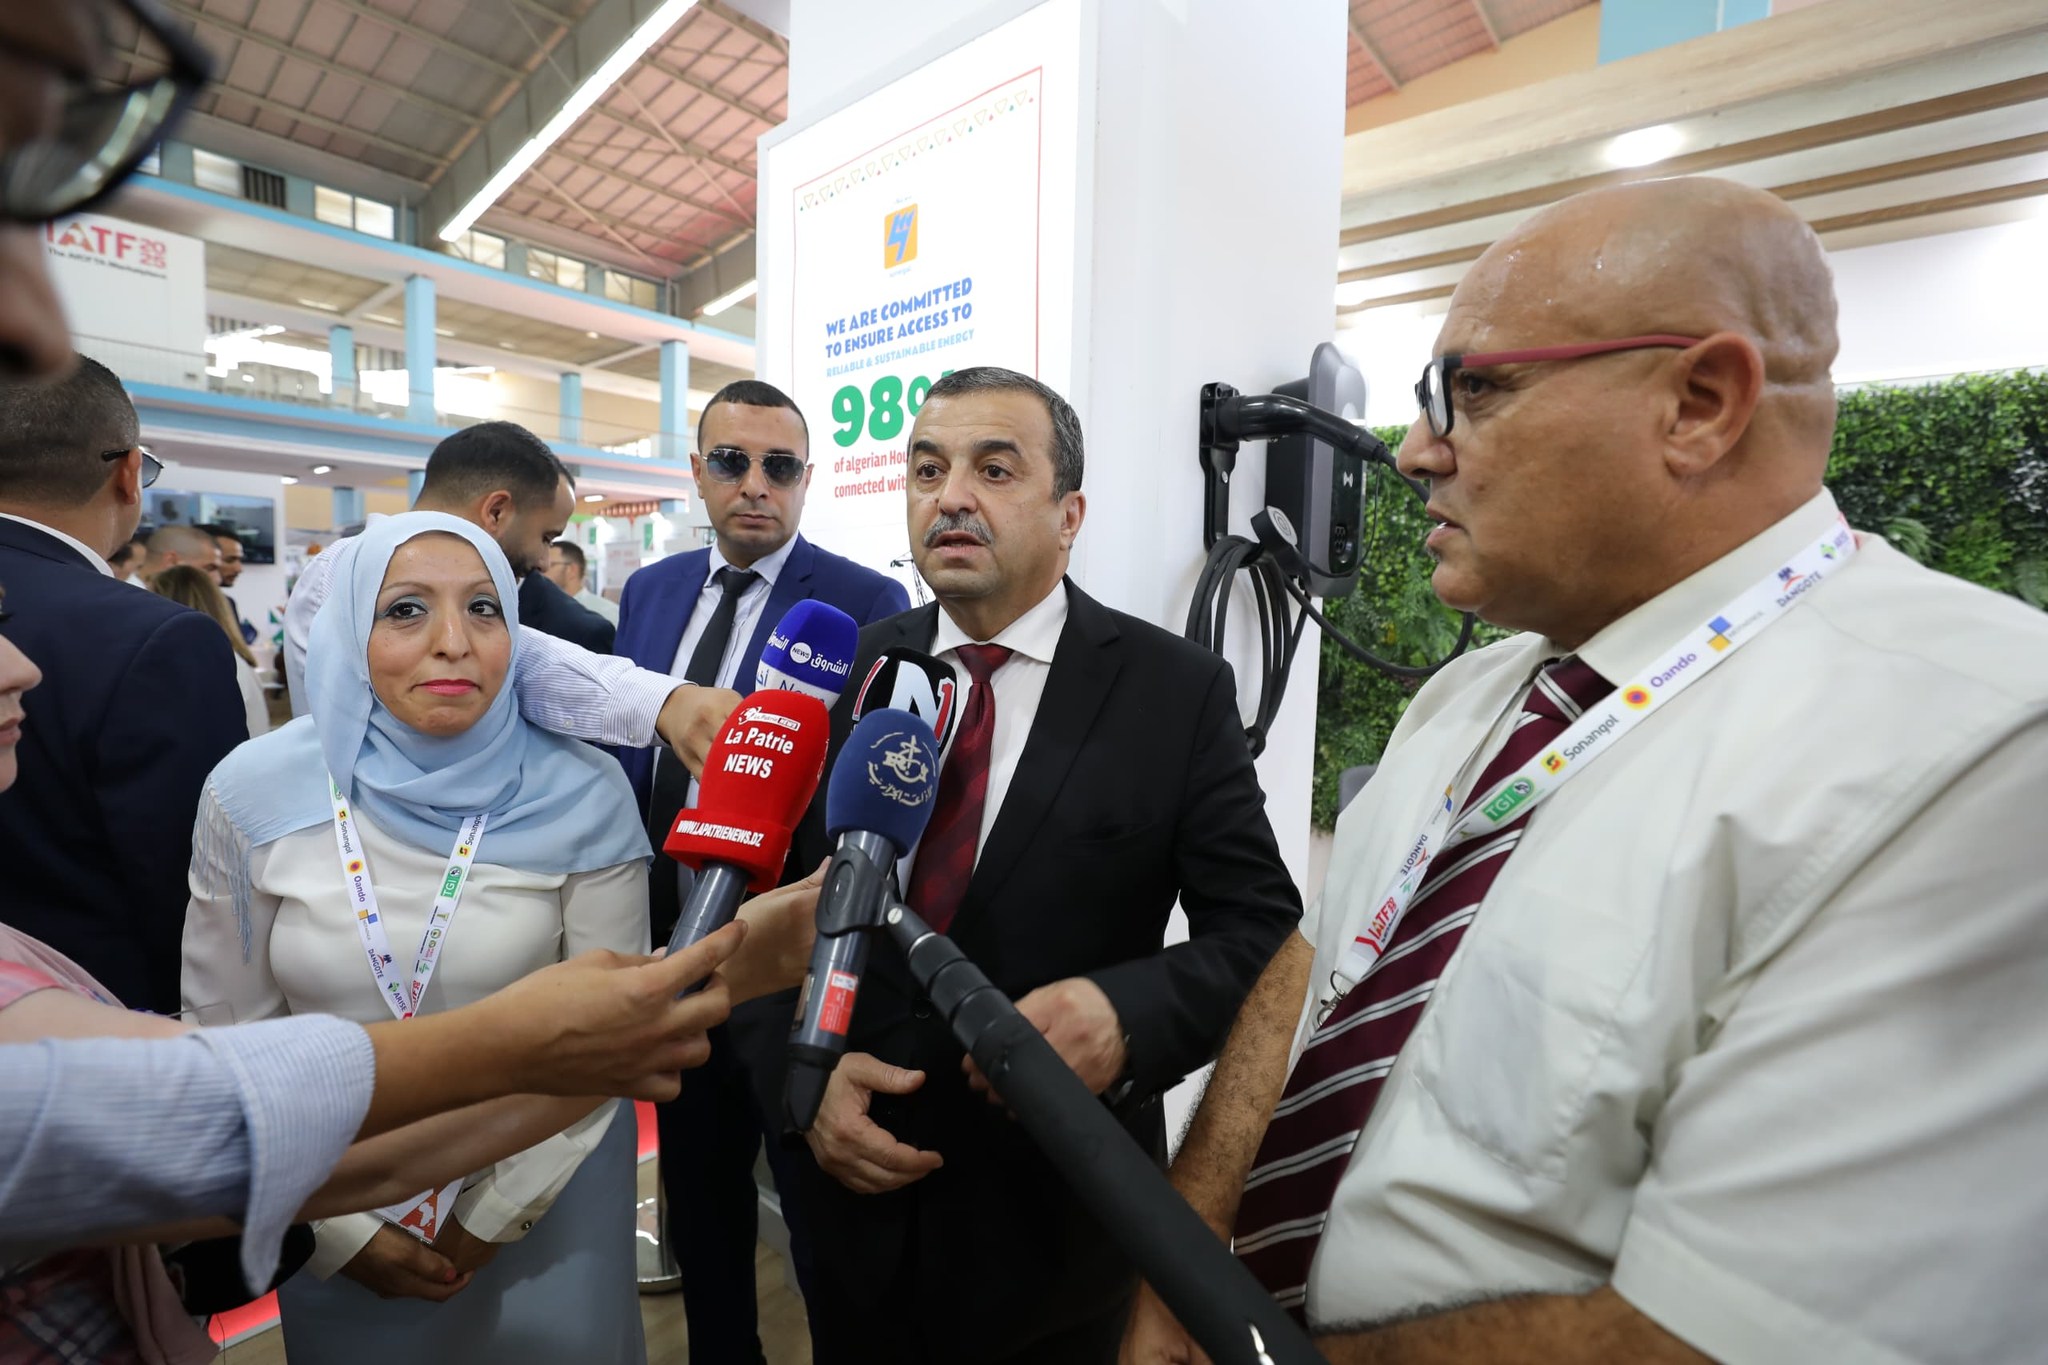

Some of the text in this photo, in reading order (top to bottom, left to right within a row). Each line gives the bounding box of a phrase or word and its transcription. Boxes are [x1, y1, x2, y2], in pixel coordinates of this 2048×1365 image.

[826, 276, 973, 338] WE ARE COMMITTED
[825, 302, 973, 359] TO ENSURE ACCESS TO
[826, 328, 975, 378] RELIABLE & SUSTAINABLE ENERGY
[834, 456, 845, 473] of
[846, 452, 887, 474] algerian
[834, 474, 906, 498] connected wit
[1776, 571, 1823, 608] DANGOTE
[791, 647, 811, 659] NEWS
[810, 653, 849, 676] الشروق
[1650, 652, 1698, 689] Oando
[724, 727, 794, 754] La Patrie
[1563, 714, 1620, 761] Sonangol
[723, 754, 773, 778] NEWS
[1486, 794, 1517, 819] TGI
[340, 820, 353, 855] Sonangol
[676, 820, 764, 847] WWW.LAPATRIENEWS.DZ
[1400, 833, 1429, 877] DANGOTE
[354, 875, 366, 903] Oando
[442, 879, 456, 897] TGI
[368, 948, 384, 979] DANGOTE
[393, 992, 408, 1013] ARISE
